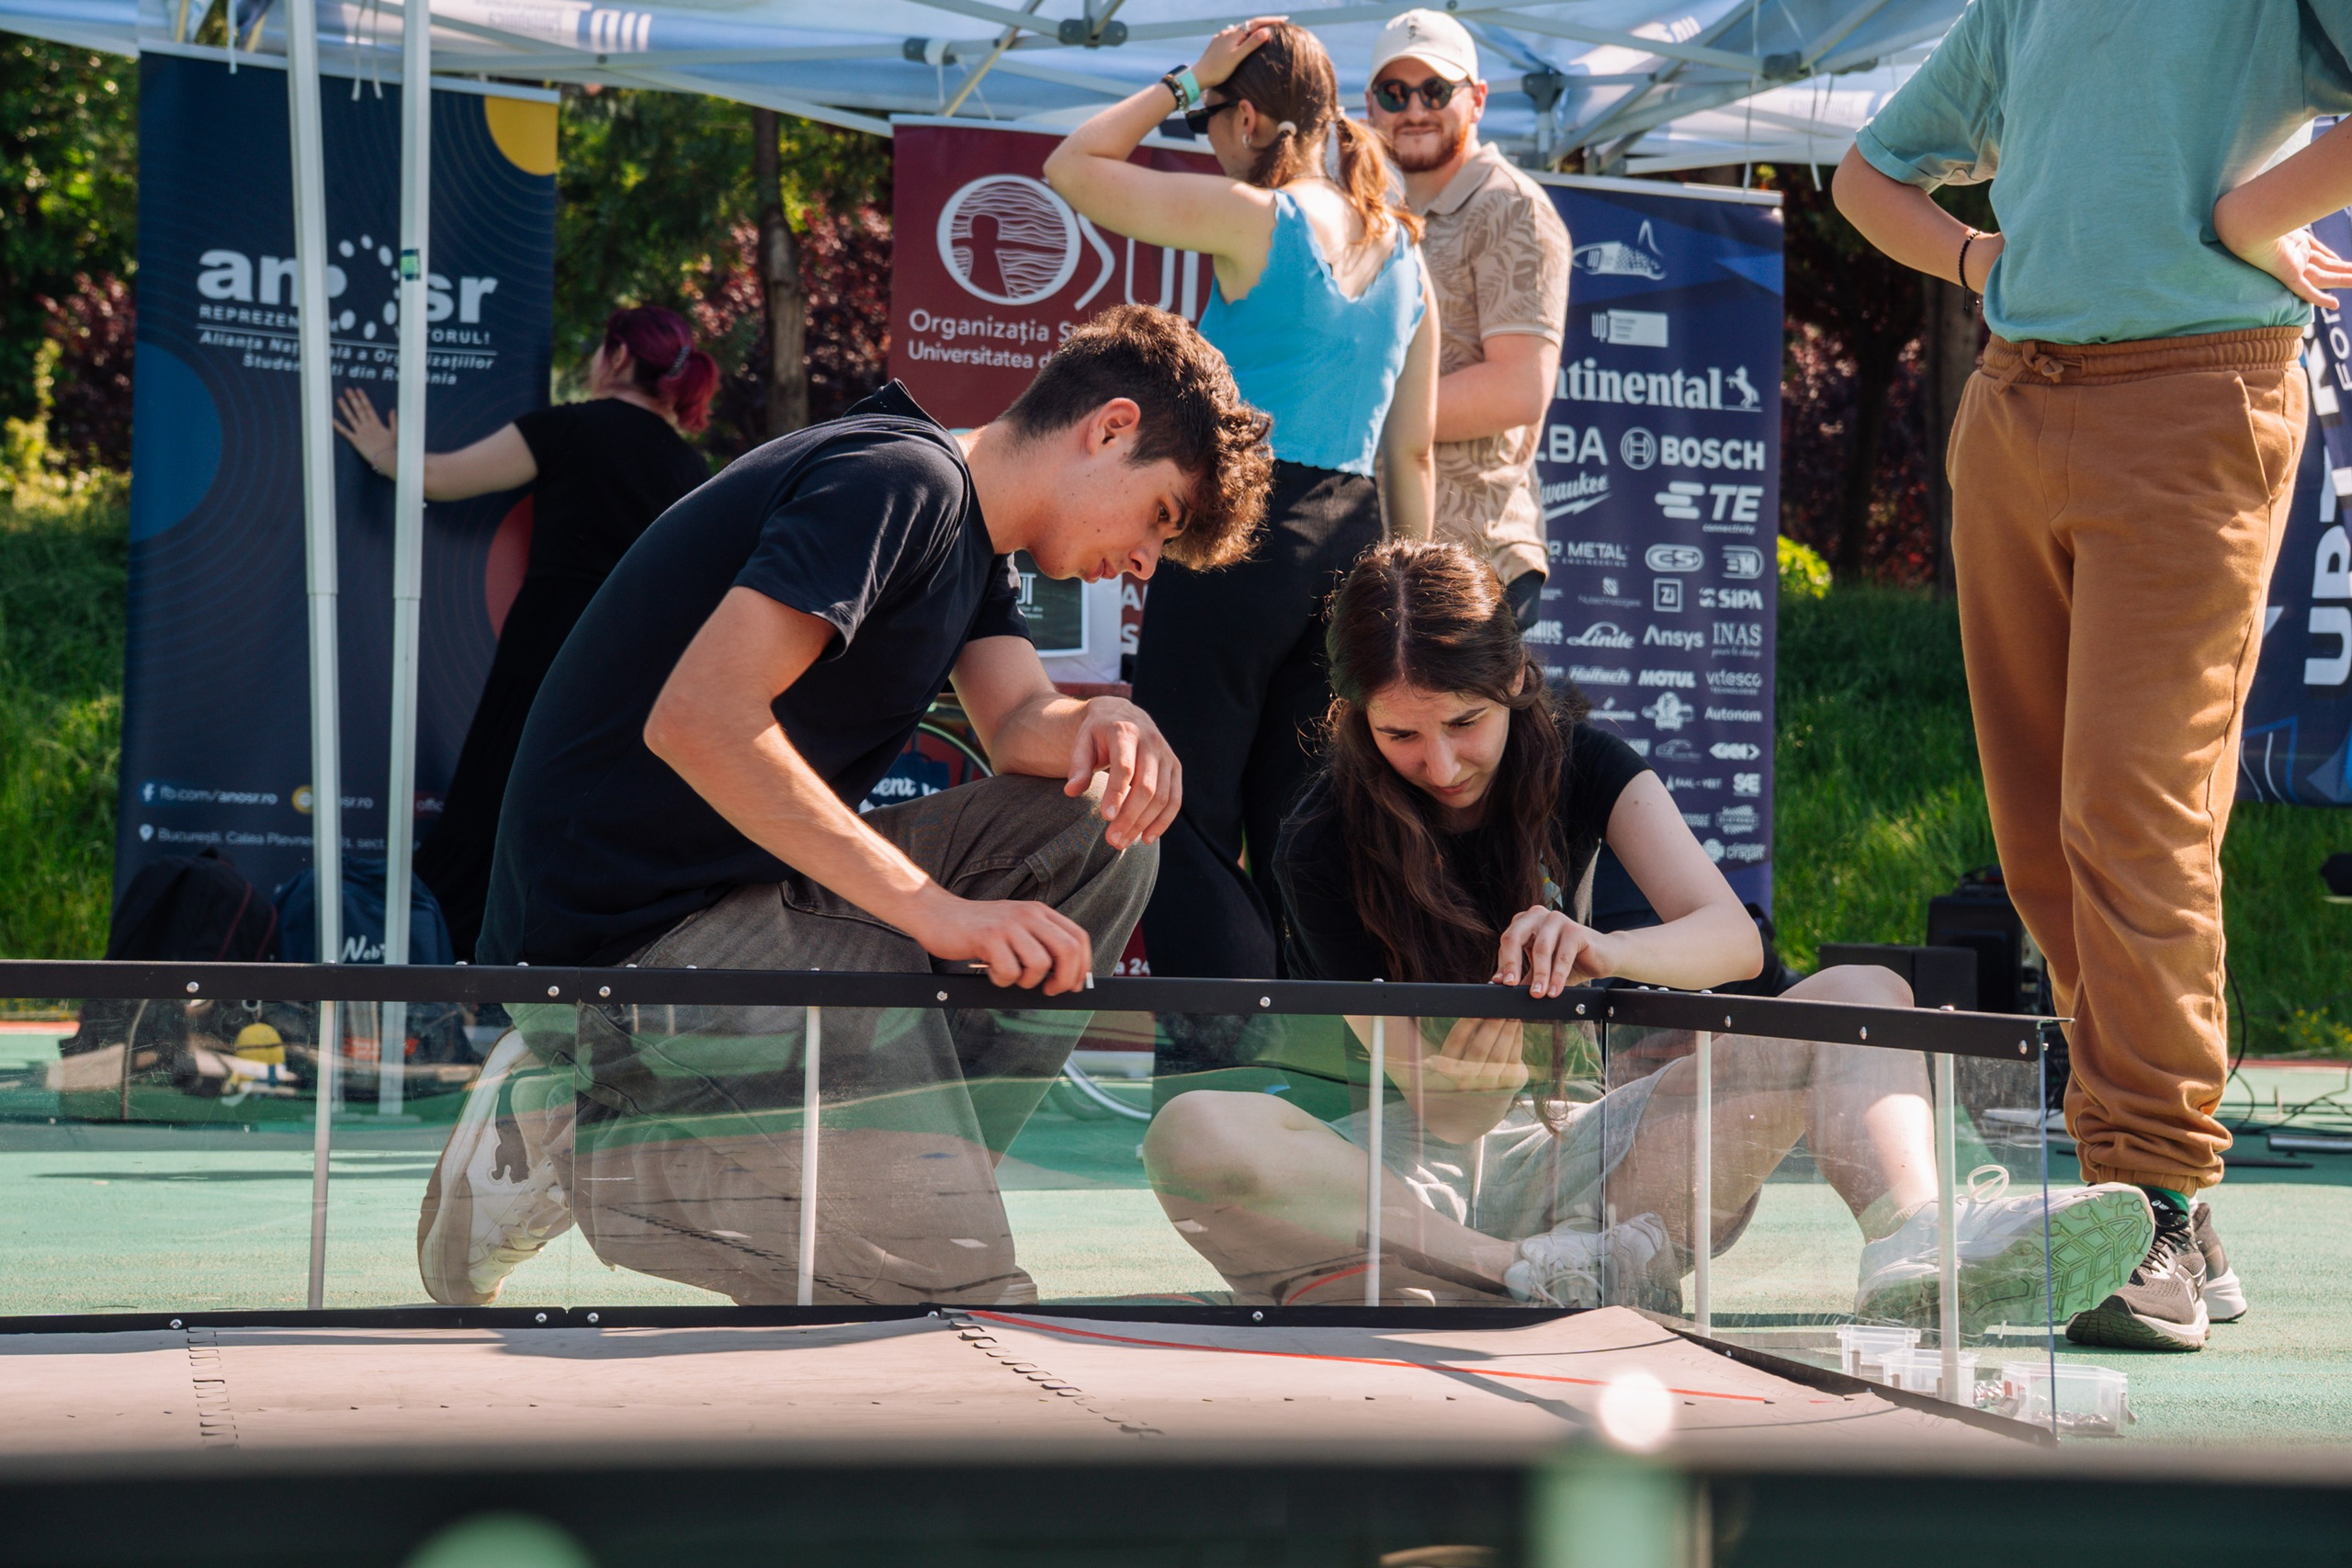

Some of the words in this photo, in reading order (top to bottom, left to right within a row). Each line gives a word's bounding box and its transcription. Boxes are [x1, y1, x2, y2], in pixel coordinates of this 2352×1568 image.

[909, 309, 1050, 346] Organizația
[373, 348, 495, 371] Orgizațiilor
[908, 339, 1035, 369] Universitatea
[1552, 356, 1724, 411] ntinental
[1660, 434, 1766, 471] BOSCH
[1539, 469, 1610, 506] waukee
[1708, 483, 1764, 523] TE
[1702, 522, 1756, 536] connectivity
[1567, 540, 1628, 562] METAL
[1643, 625, 1706, 652] Ansys
[1712, 621, 1763, 647] INAS
[1637, 669, 1697, 689] MOTUL
[1704, 706, 1763, 723] Autonom
[266, 831, 313, 848] Plevne
